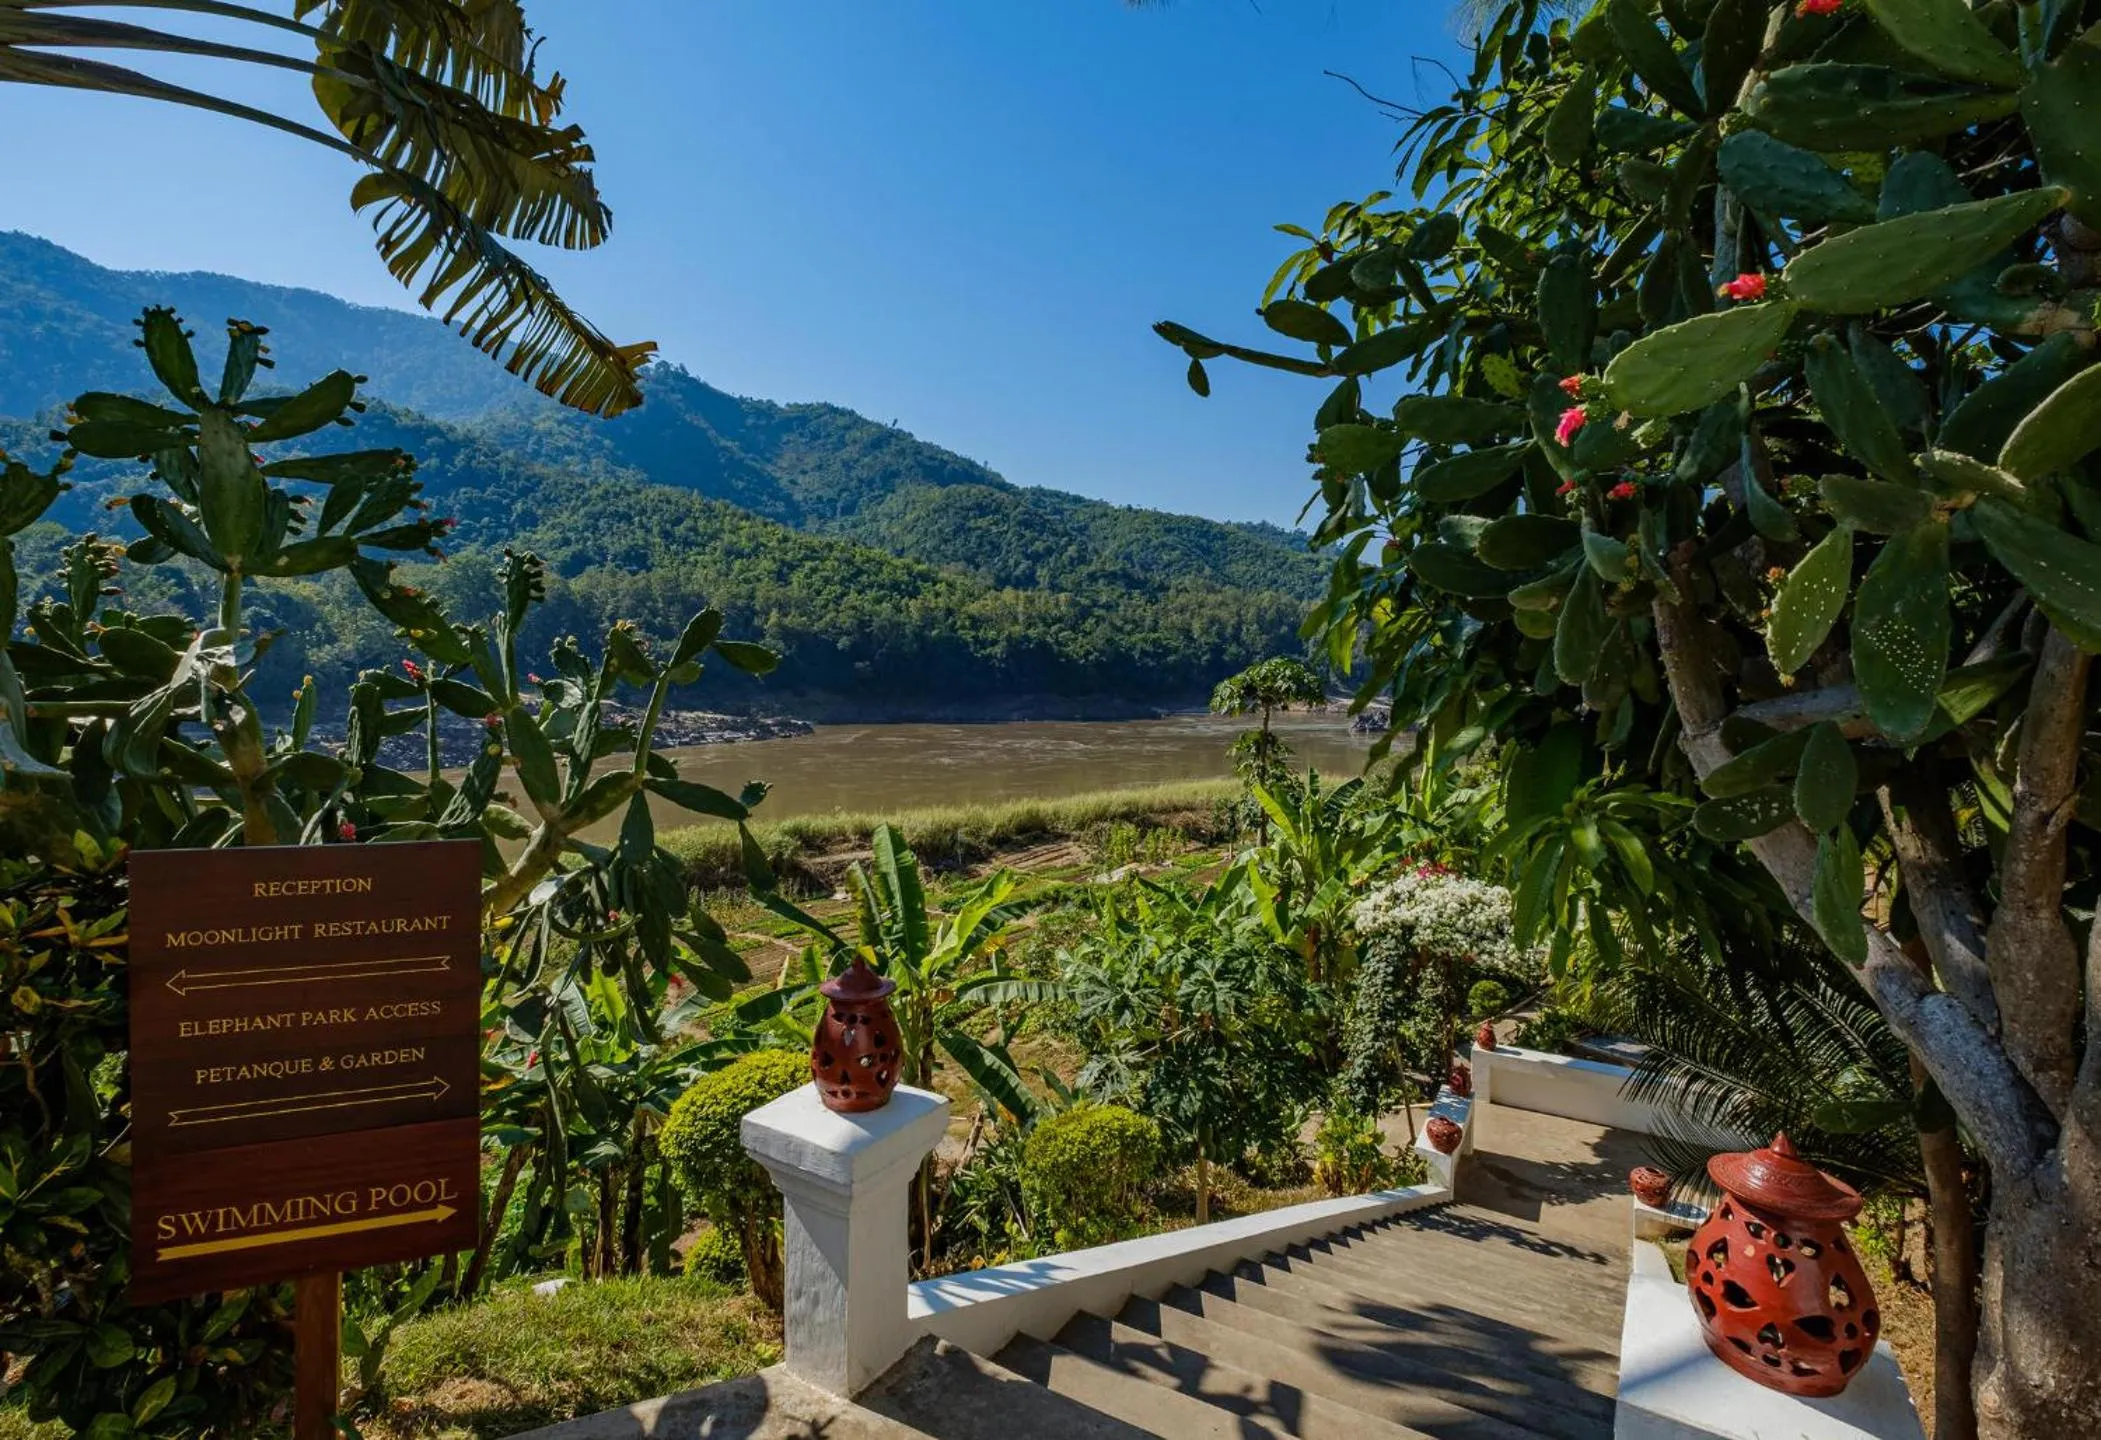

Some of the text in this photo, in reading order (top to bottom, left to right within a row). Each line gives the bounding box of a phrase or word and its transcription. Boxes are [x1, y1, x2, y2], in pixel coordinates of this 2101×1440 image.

[252, 877, 373, 897] RECEPTION
[165, 915, 451, 948] MOONLIGHT RESTAURANT
[178, 1000, 441, 1038] ELEPHANT PARK ACCESS
[195, 1047, 426, 1085] PETANQUE & GARDEN
[156, 1177, 459, 1241] SWIMMING POOL
